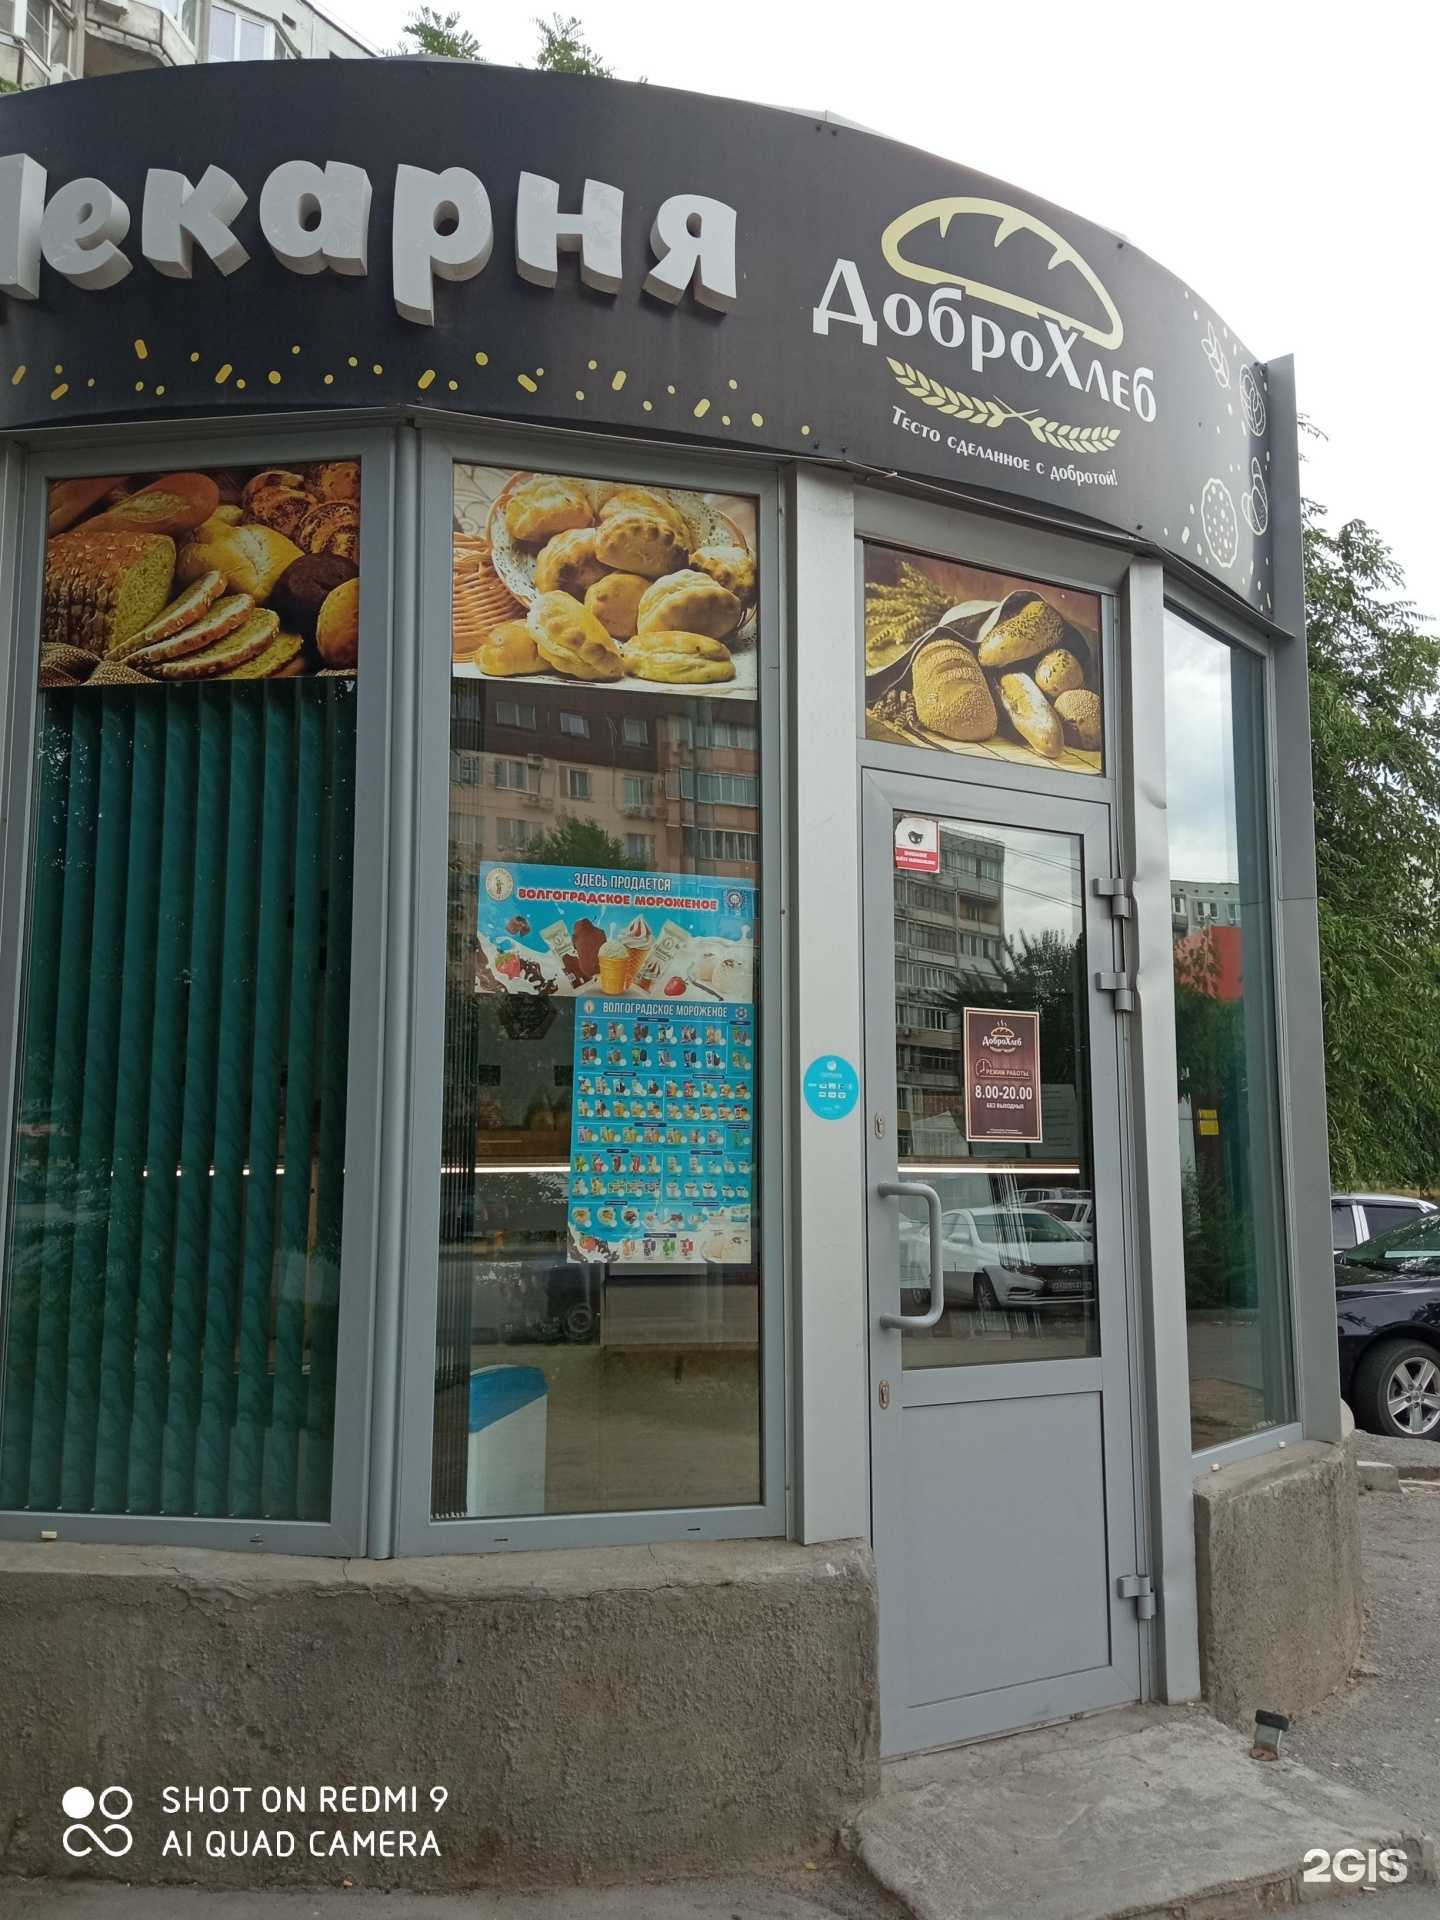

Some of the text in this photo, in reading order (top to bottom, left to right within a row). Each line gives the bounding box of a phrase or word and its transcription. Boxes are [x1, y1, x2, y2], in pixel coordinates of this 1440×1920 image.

[890, 405, 941, 442] Тесто
[1035, 462, 1045, 474] с
[1050, 464, 1118, 487] добротой!
[573, 872, 672, 892] ЗДЕСЬ ПРОДАЕТСЯ
[517, 888, 718, 911] ВОЛГОГРАДСКОЕ МОРОЖЕНОЕ
[602, 1001, 728, 1018] ВОЛГОГРАДСКОЕ МОРОЖЕНОЕ
[975, 1085, 1033, 1100] 8.00-20.00
